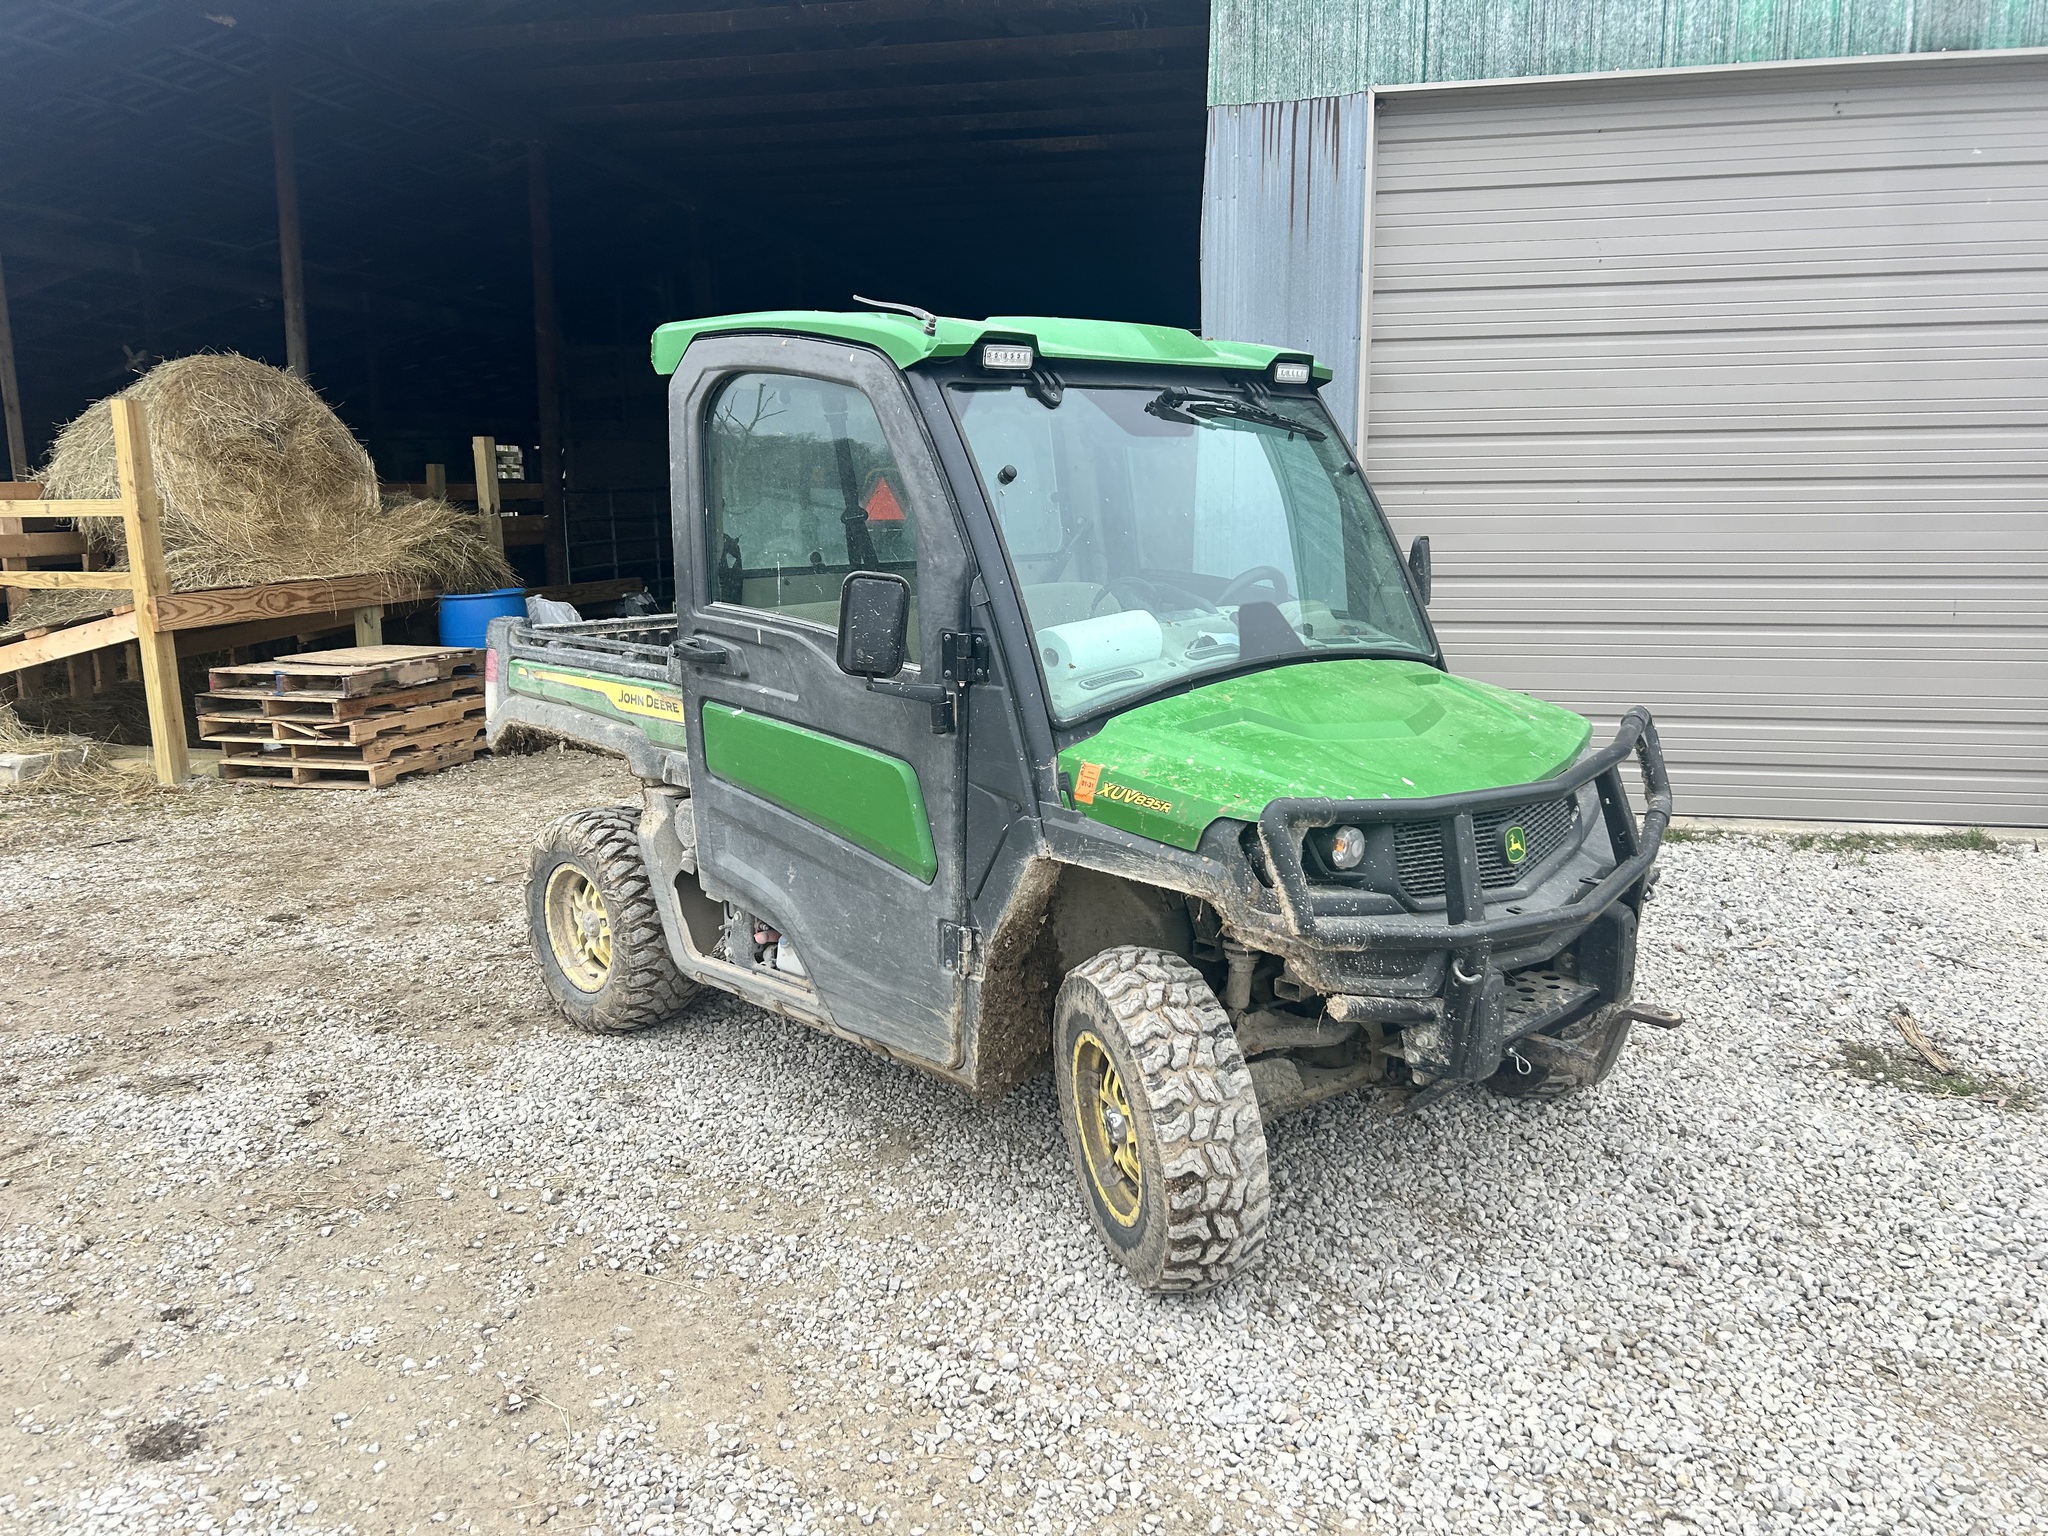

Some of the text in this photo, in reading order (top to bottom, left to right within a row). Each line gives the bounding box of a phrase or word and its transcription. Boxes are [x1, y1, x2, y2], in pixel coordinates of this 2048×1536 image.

[618, 690, 680, 713] JOHN DEERE
[1094, 781, 1172, 815] XUV835R
